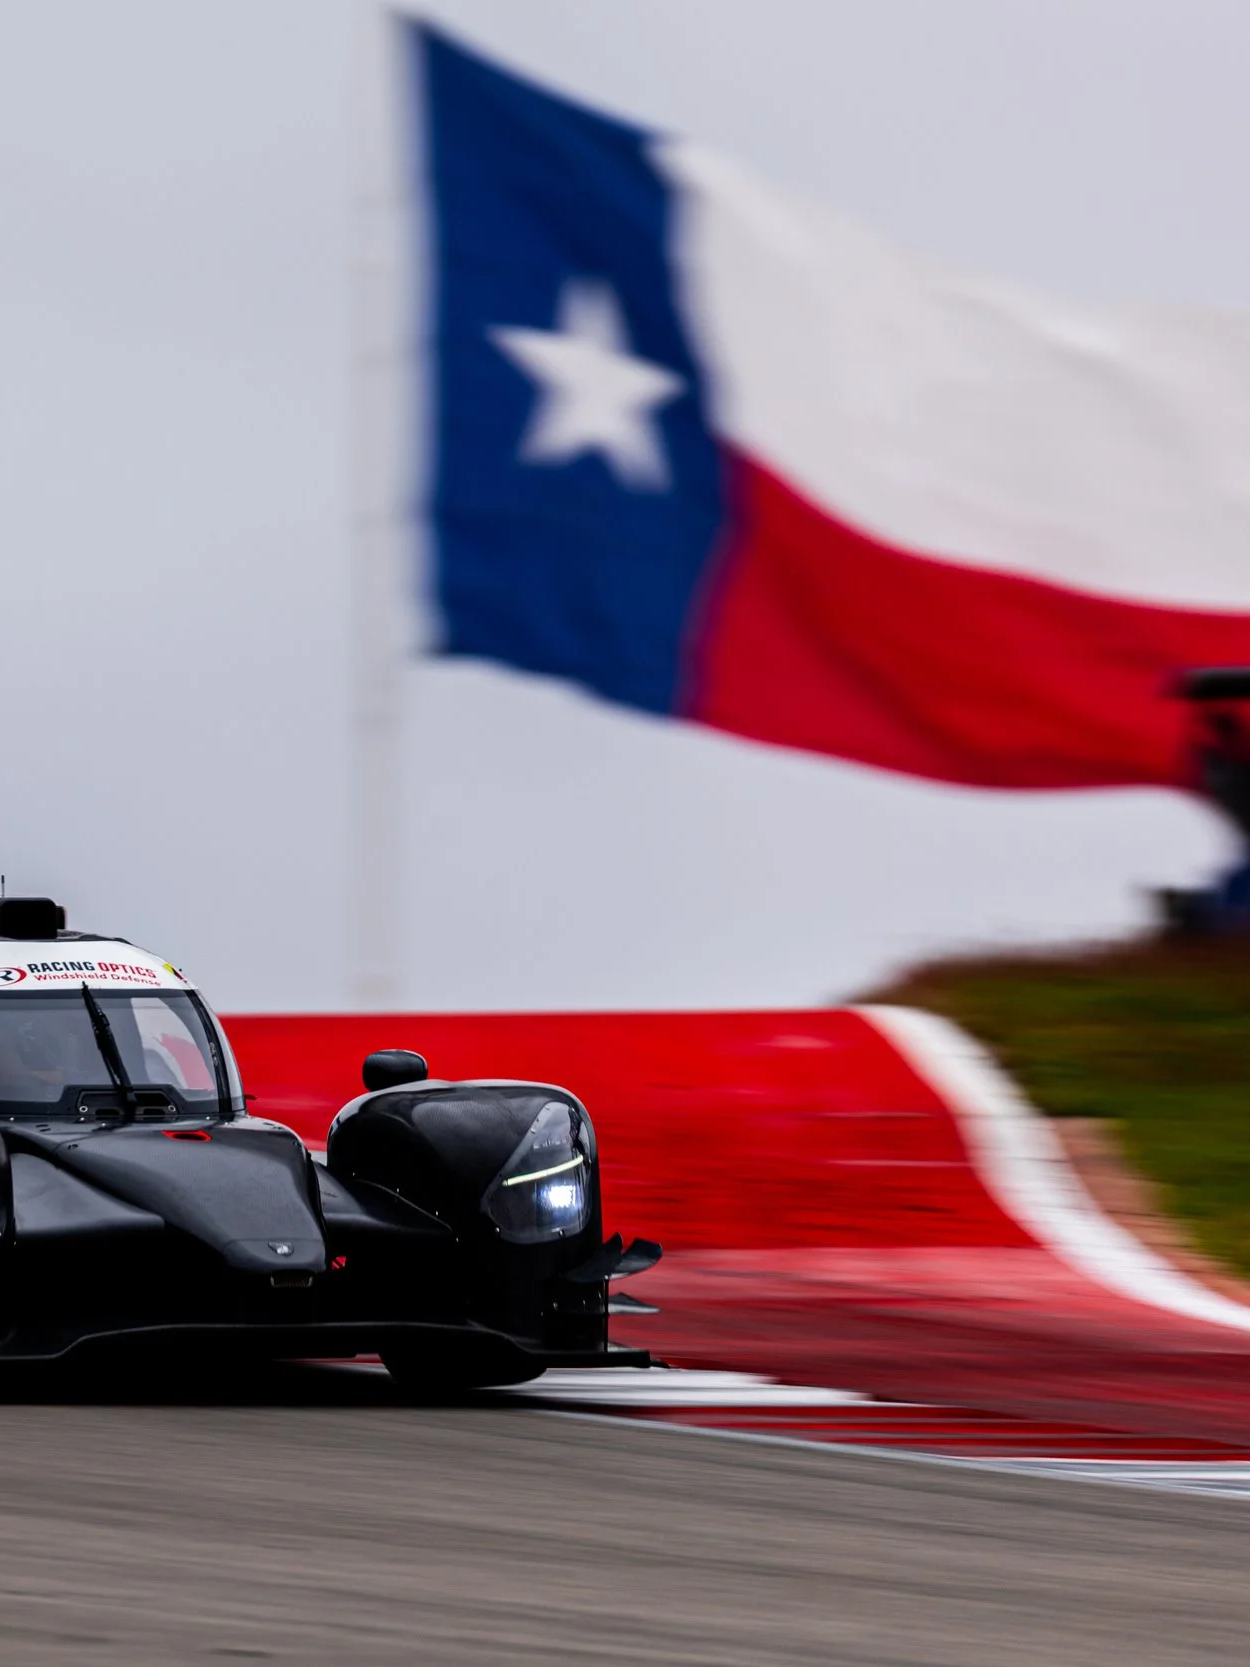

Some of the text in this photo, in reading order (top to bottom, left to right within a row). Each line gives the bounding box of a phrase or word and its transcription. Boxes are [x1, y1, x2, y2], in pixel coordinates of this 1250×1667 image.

[27, 961, 157, 979] RACING OPTICS
[34, 972, 161, 987] Windshield Defense
